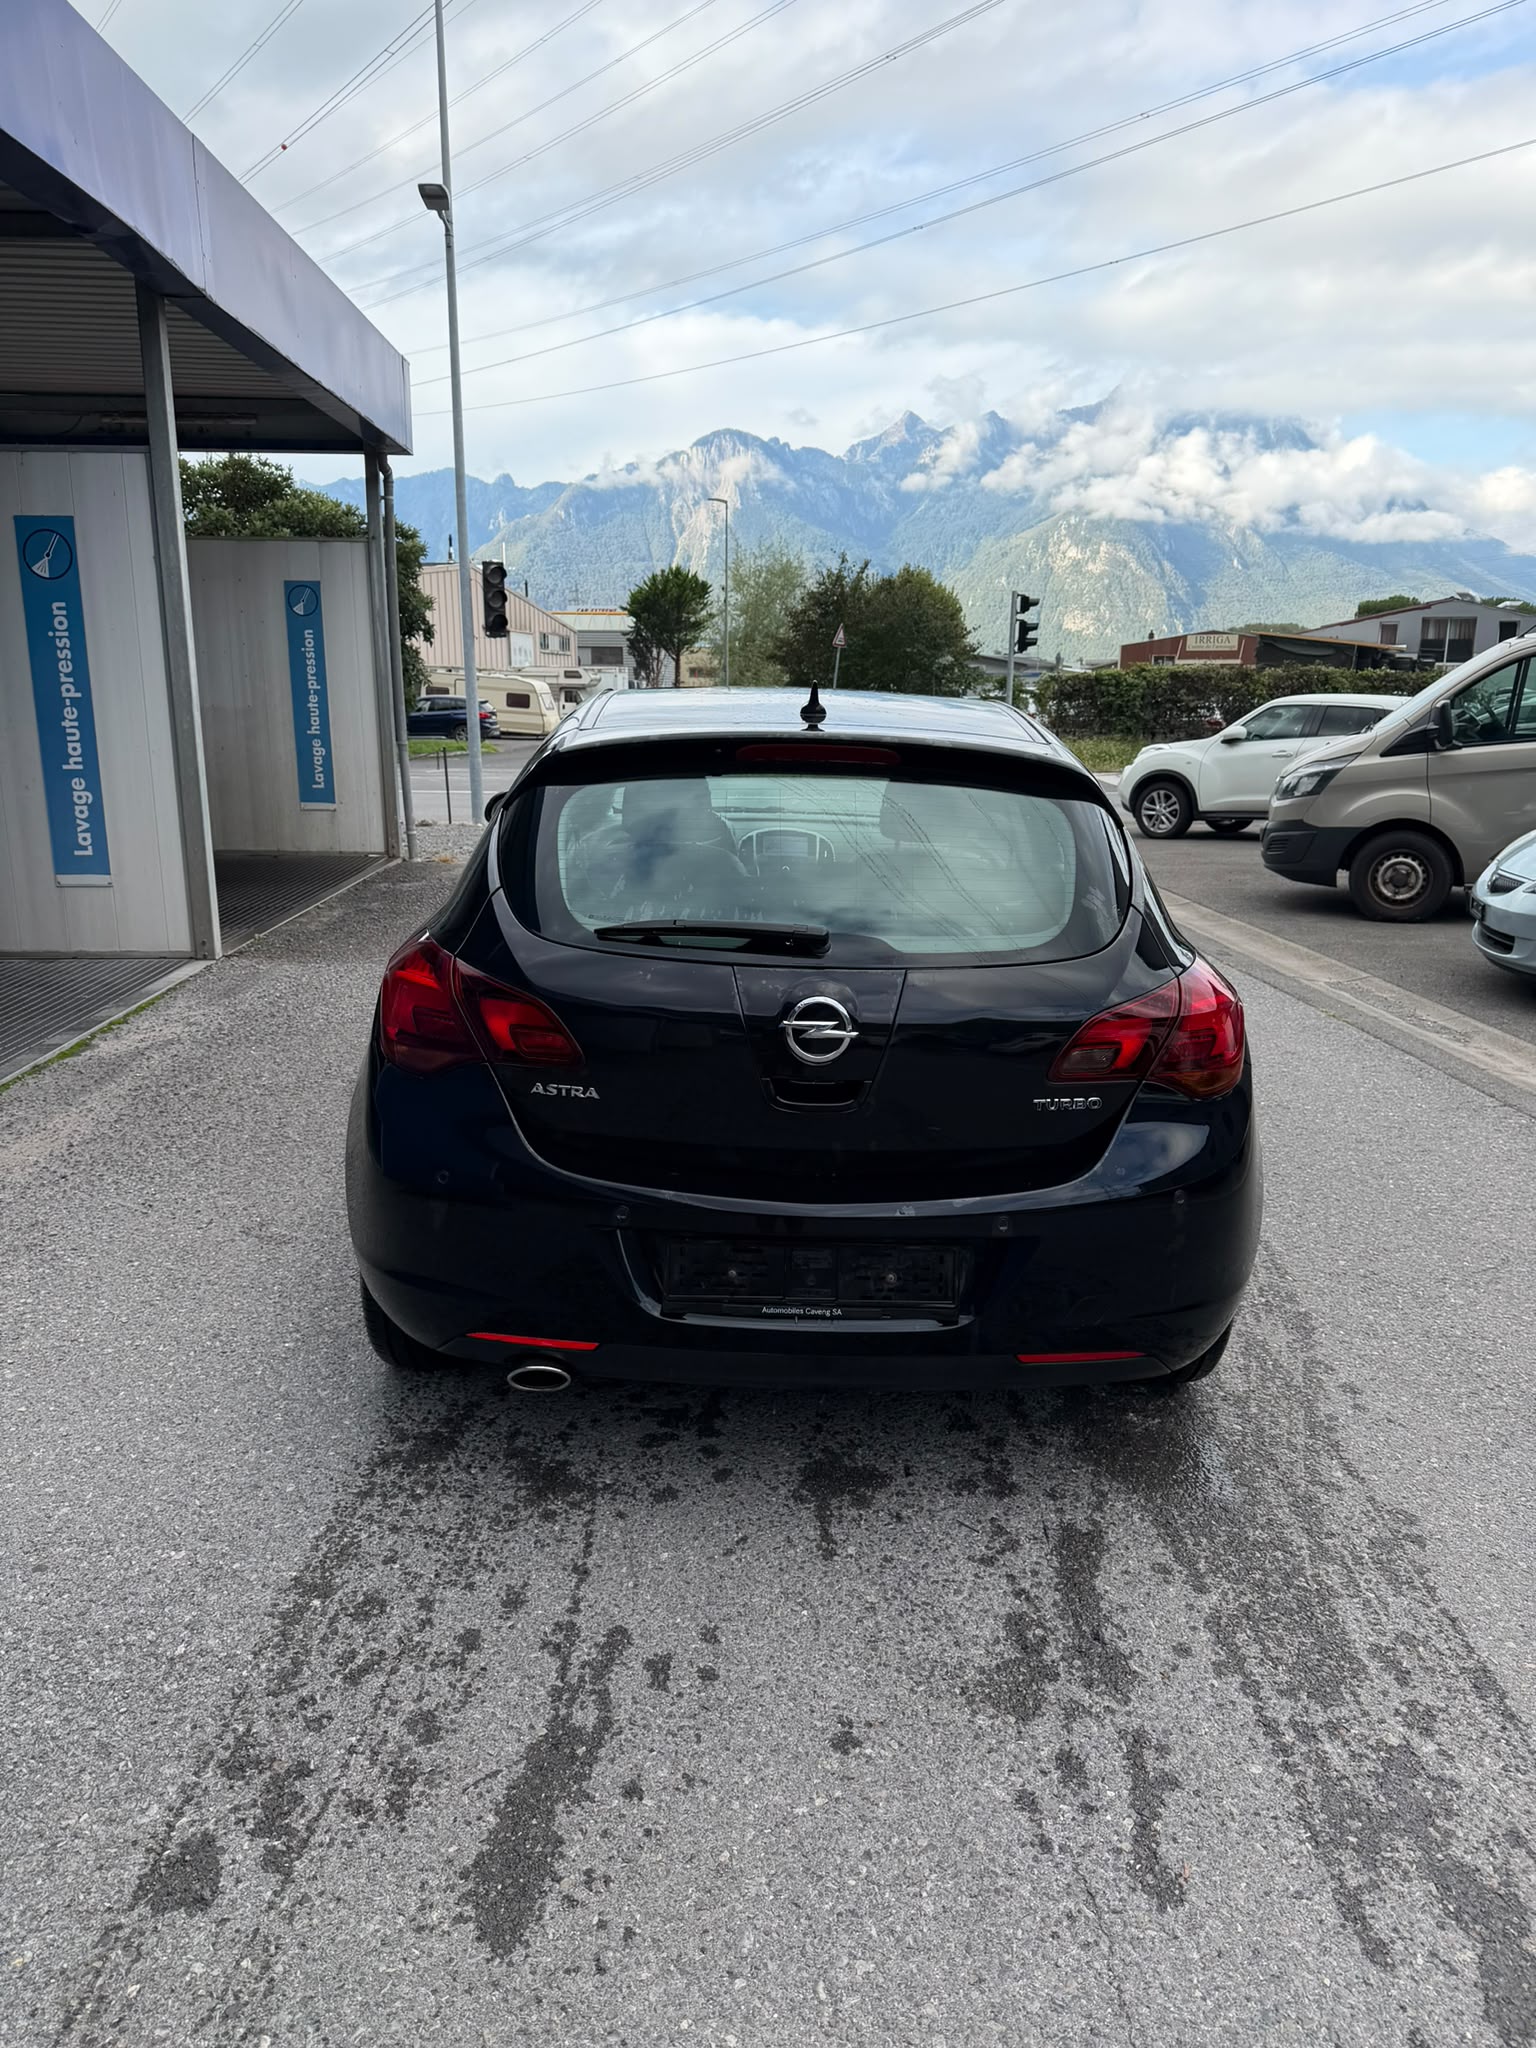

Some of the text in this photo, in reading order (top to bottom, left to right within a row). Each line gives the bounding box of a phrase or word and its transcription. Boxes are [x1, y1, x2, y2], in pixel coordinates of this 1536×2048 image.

[1194, 635, 1231, 644] IRRIGA
[301, 629, 326, 789] Lavage haute-pression
[48, 601, 94, 856] Lavage haute-pression
[530, 1082, 600, 1100] ASTRA
[1033, 1097, 1102, 1111] TURBO
[761, 1306, 804, 1315] Automobiles
[832, 1308, 843, 1316] SA
